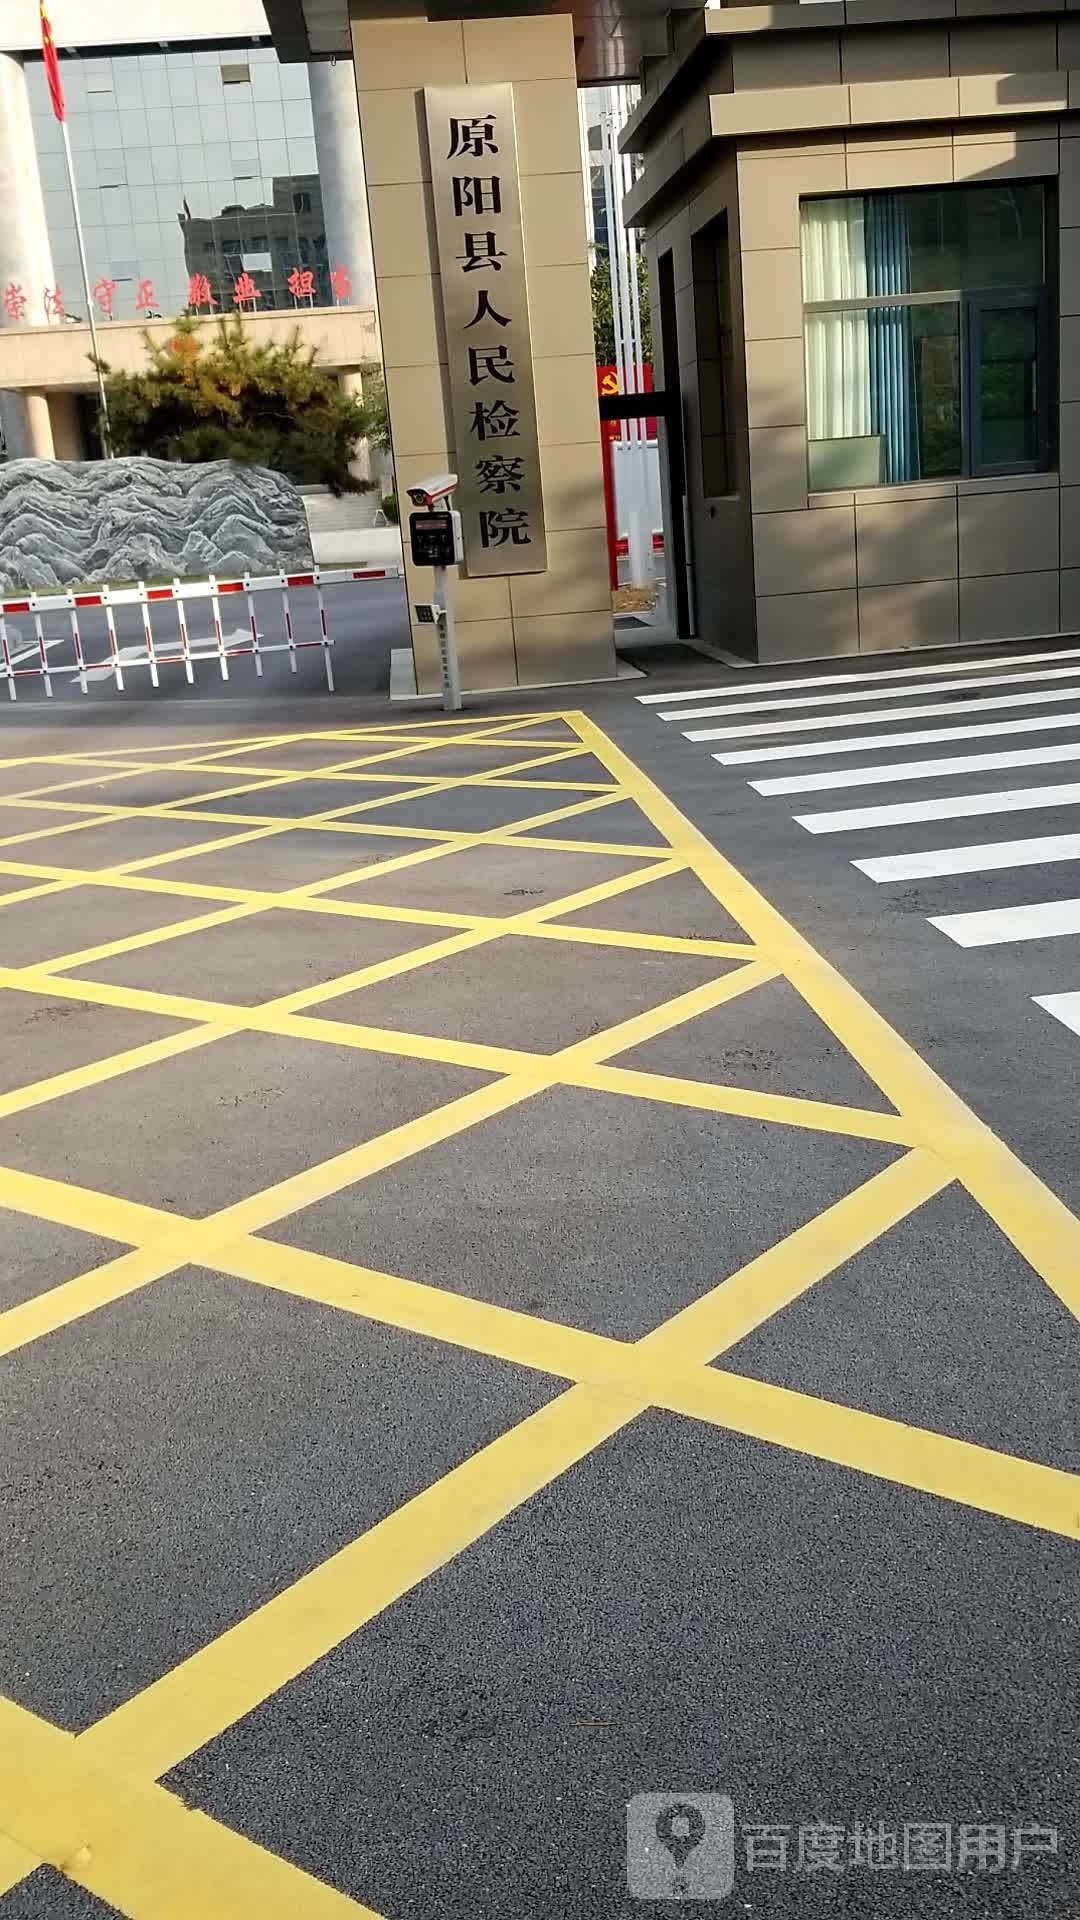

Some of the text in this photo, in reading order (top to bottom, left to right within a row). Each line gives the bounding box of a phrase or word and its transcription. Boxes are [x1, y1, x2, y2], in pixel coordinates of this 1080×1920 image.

[446, 114, 531, 548] 原阳县人民检察院
